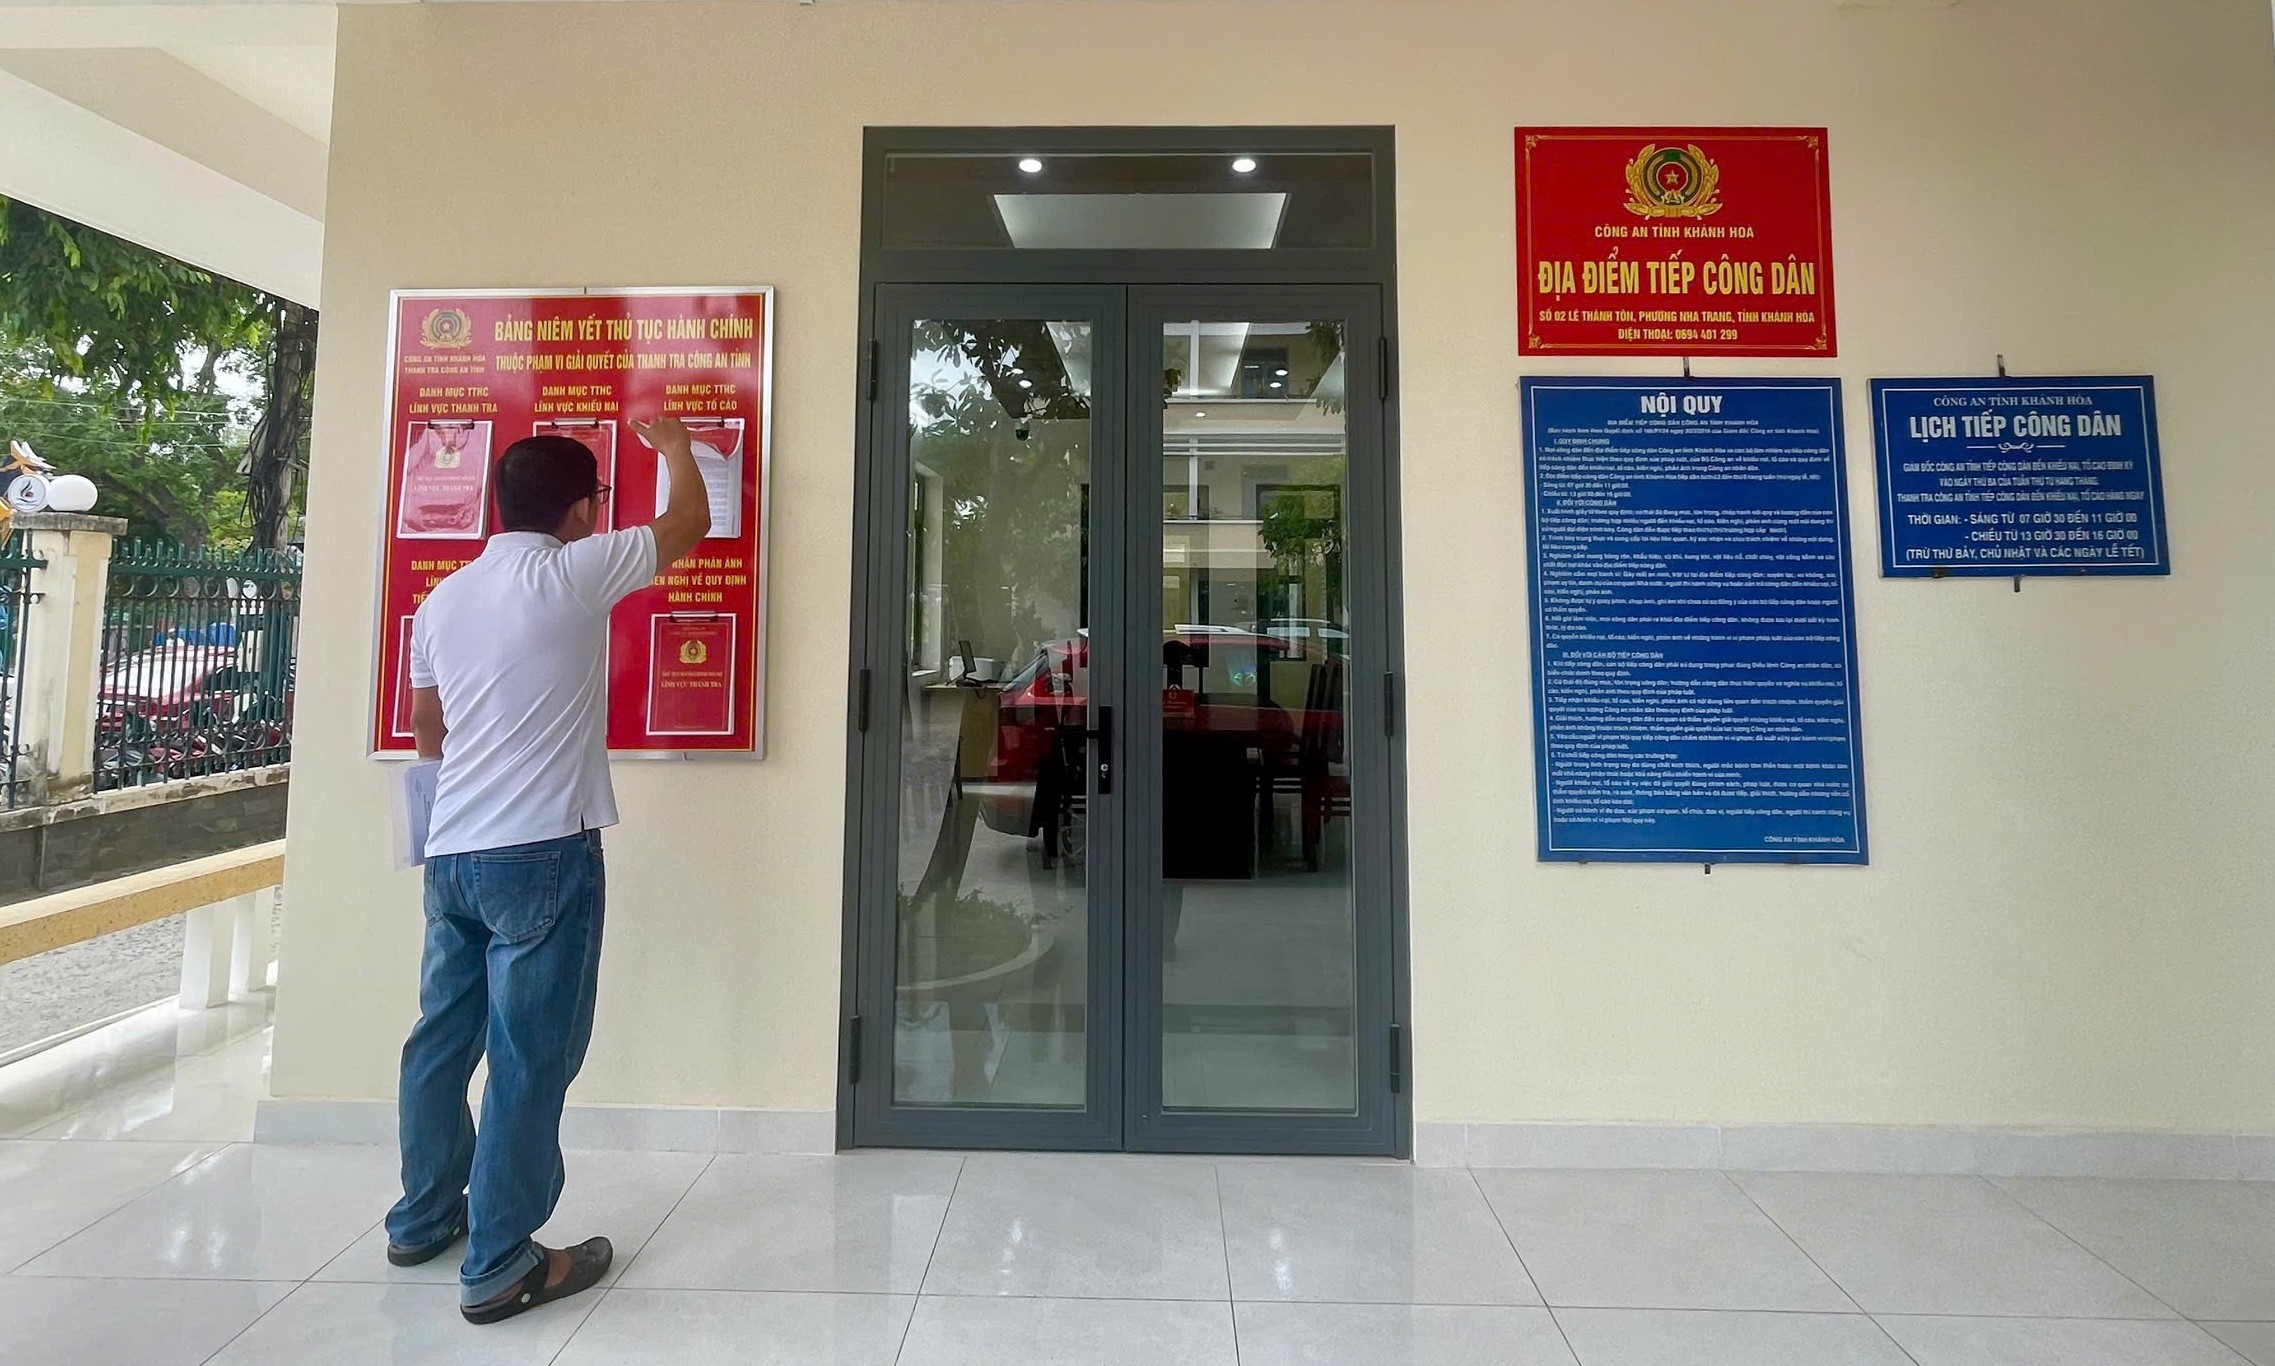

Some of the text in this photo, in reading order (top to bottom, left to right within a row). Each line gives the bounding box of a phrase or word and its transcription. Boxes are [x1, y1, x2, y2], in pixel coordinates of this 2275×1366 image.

[1595, 223, 1628, 238] CÔNG
[1632, 226, 1648, 238] AN
[1652, 223, 1680, 238] TỈNH
[1684, 224, 1725, 238] KHÁNH
[1538, 246, 1815, 301] ĐỊA ĐIỂM TIẾP CÔNG DÂN
[1554, 310, 1566, 321] 02
[1680, 311, 1699, 322] NHA
[495, 312, 753, 345] BẢNG NIÊM YẾT THỦ TỤC HÀNH CHÍNH
[1618, 327, 1640, 342] ĐIỆN
[1700, 329, 1717, 340] 401
[1720, 329, 1738, 340] 299
[496, 348, 751, 373] THUỘC PHẠM VI GIẢI QUYẾT CỦA THANH TRA CÔNG AN TỈNH
[419, 386, 489, 399] DANH MỤC TTHC
[542, 386, 612, 397] DANH MỤC TTHC
[665, 384, 736, 396] DANH MỤC TTHC
[1641, 392, 1723, 417] NỘI QUY
[1934, 395, 1967, 407] CÔNG
[1970, 397, 1986, 406] AN
[1988, 394, 2018, 406] TỈNH
[2021, 393, 2064, 406] KHÁNH
[451, 403, 479, 413] THANH
[481, 403, 497, 413] TRA
[1910, 409, 2121, 443] LỊCH TIẾP CÔNG DÂN
[1907, 512, 1931, 525] THỜI
[1934, 514, 1962, 525] GIAN:
[1970, 511, 1999, 524] SÁNG
[2001, 511, 2015, 524] TỪ
[2019, 514, 2030, 524] 07
[2033, 511, 2051, 524] GIỜ
[2053, 513, 2065, 524] 30
[2067, 509, 2089, 523] ĐẾN
[2091, 513, 2102, 523] 11
[2004, 529, 2018, 541] TỪ
[2020, 530, 2031, 541] 13
[2034, 528, 2052, 541] GIỜ
[2054, 530, 2066, 540] 30
[2068, 526, 2090, 540] ĐẾN
[411, 560, 434, 571] DANH
[437, 560, 457, 572] MỤC
[706, 575, 722, 586] QUY
